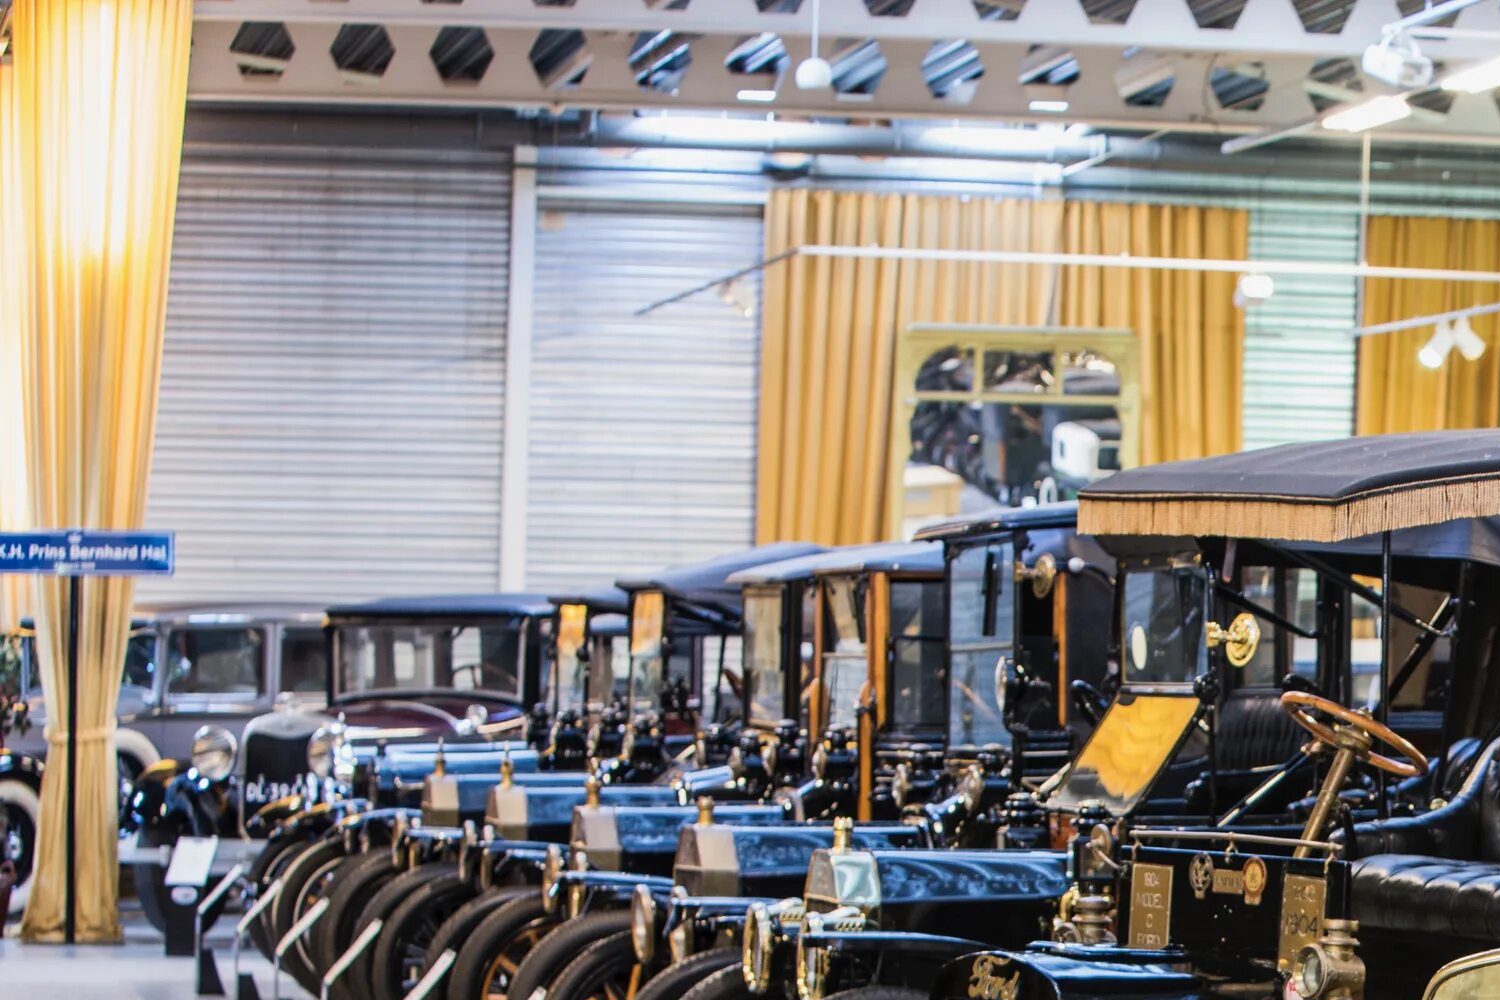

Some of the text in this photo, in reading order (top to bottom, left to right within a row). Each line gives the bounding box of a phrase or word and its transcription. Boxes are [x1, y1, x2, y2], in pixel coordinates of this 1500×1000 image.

[29, 544, 66, 560] Prins
[70, 544, 138, 560] Bernhard
[1136, 892, 1165, 908] MODEL
[1146, 913, 1153, 928] C
